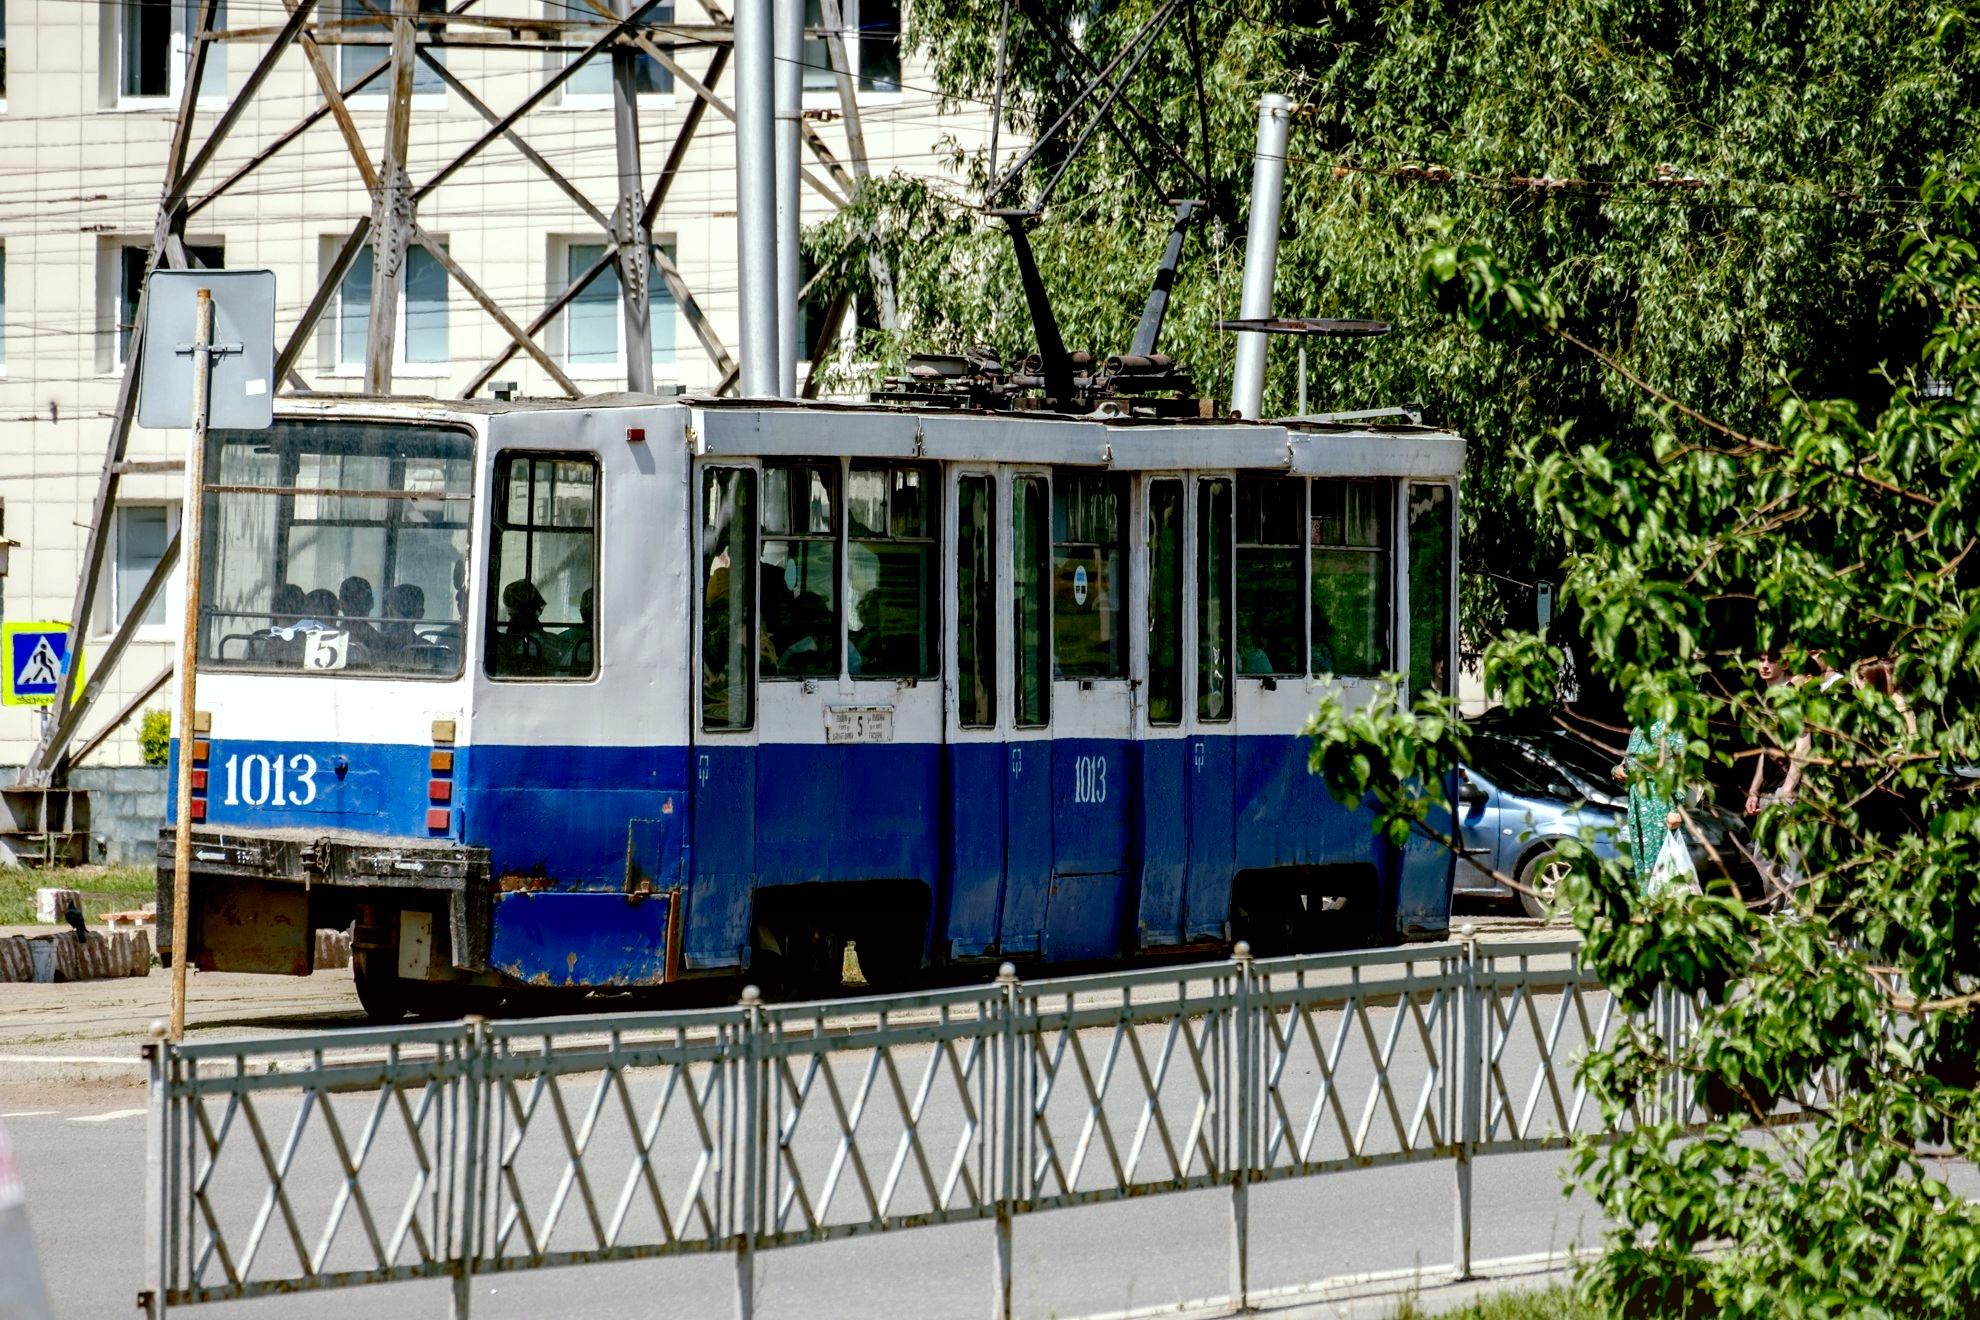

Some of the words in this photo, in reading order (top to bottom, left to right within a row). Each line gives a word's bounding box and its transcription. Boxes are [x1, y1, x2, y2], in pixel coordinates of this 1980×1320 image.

[313, 632, 340, 669] 5
[857, 715, 863, 737] 5
[224, 753, 317, 806] 1013
[1074, 755, 1107, 803] 1013
